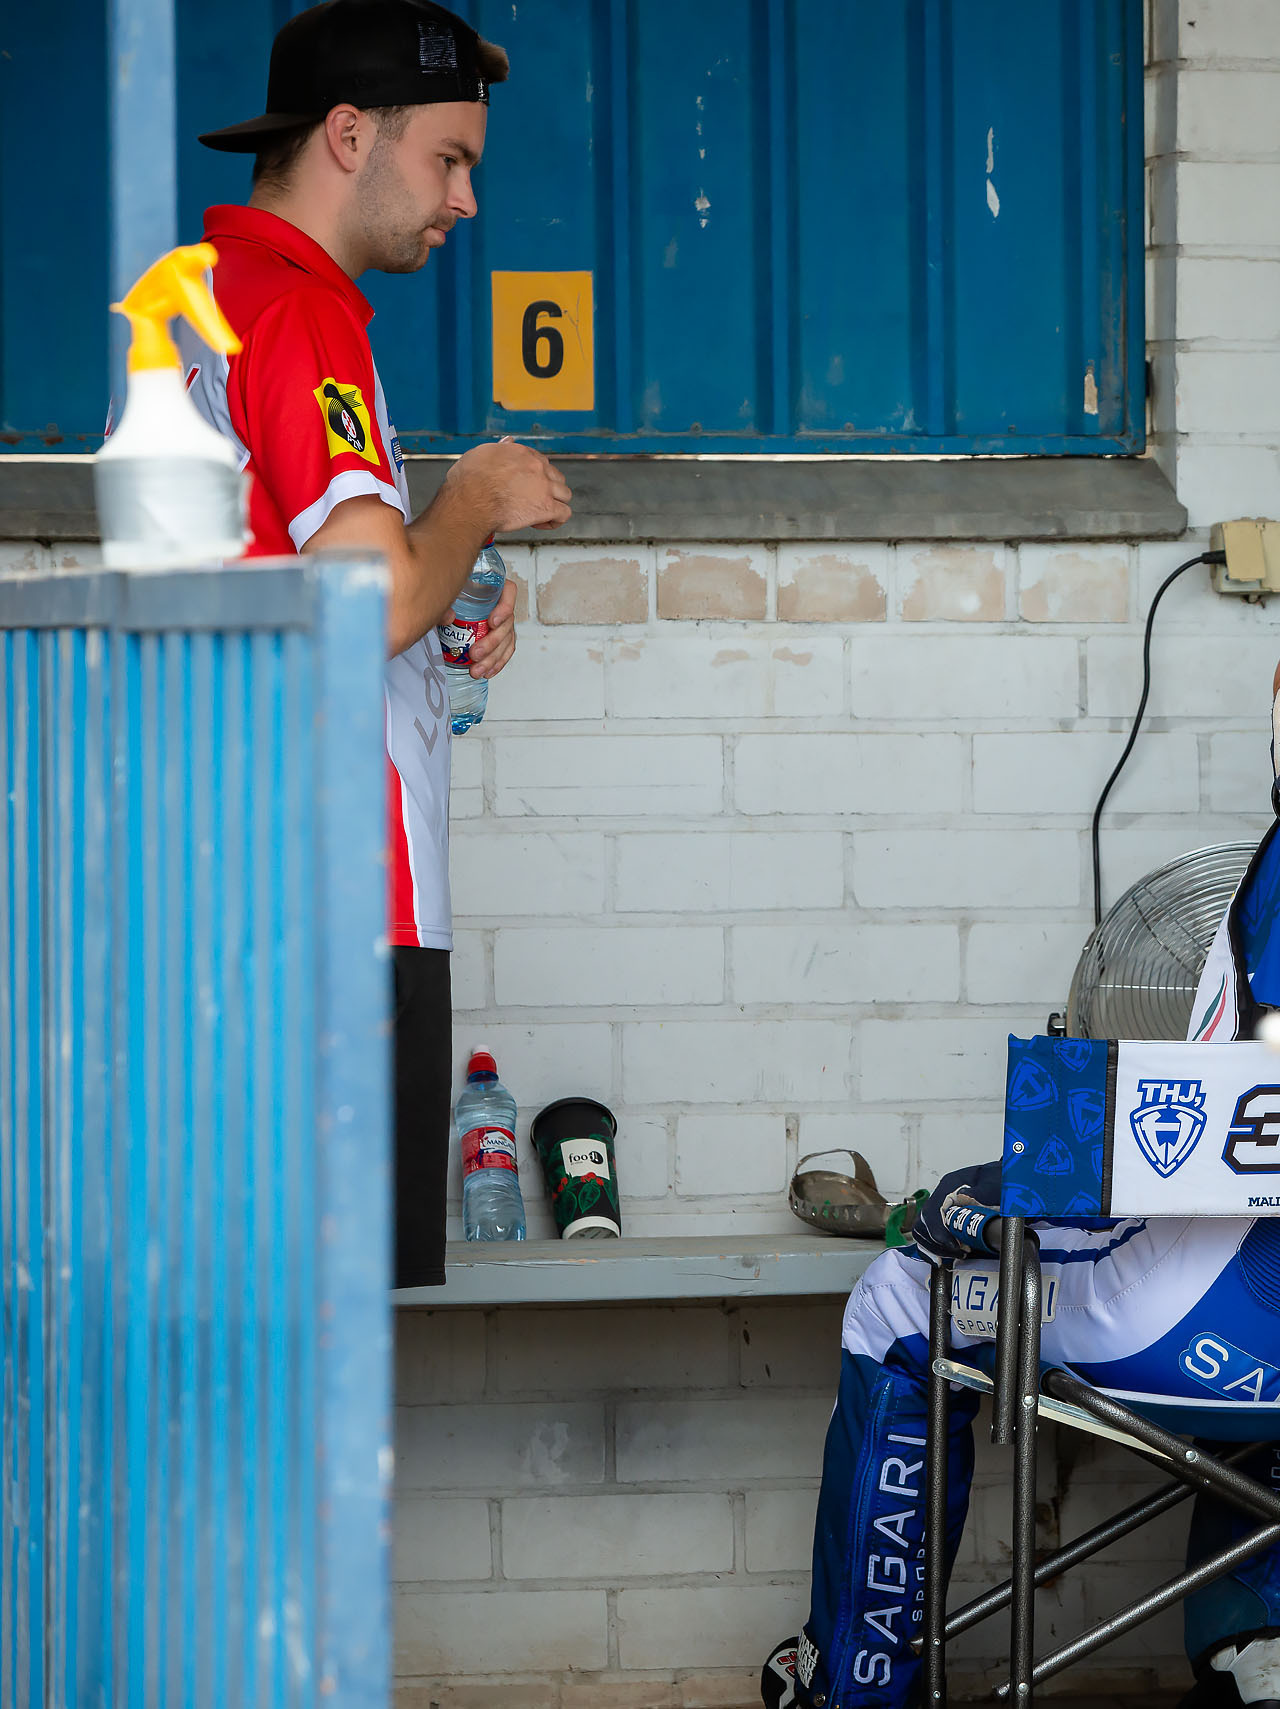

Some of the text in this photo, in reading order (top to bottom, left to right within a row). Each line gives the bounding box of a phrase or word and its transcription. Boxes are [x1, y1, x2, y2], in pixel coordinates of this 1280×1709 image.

[521, 300, 564, 379] 6
[956, 1319, 997, 1333] SPOR
[853, 1434, 927, 1687] SAGARI
